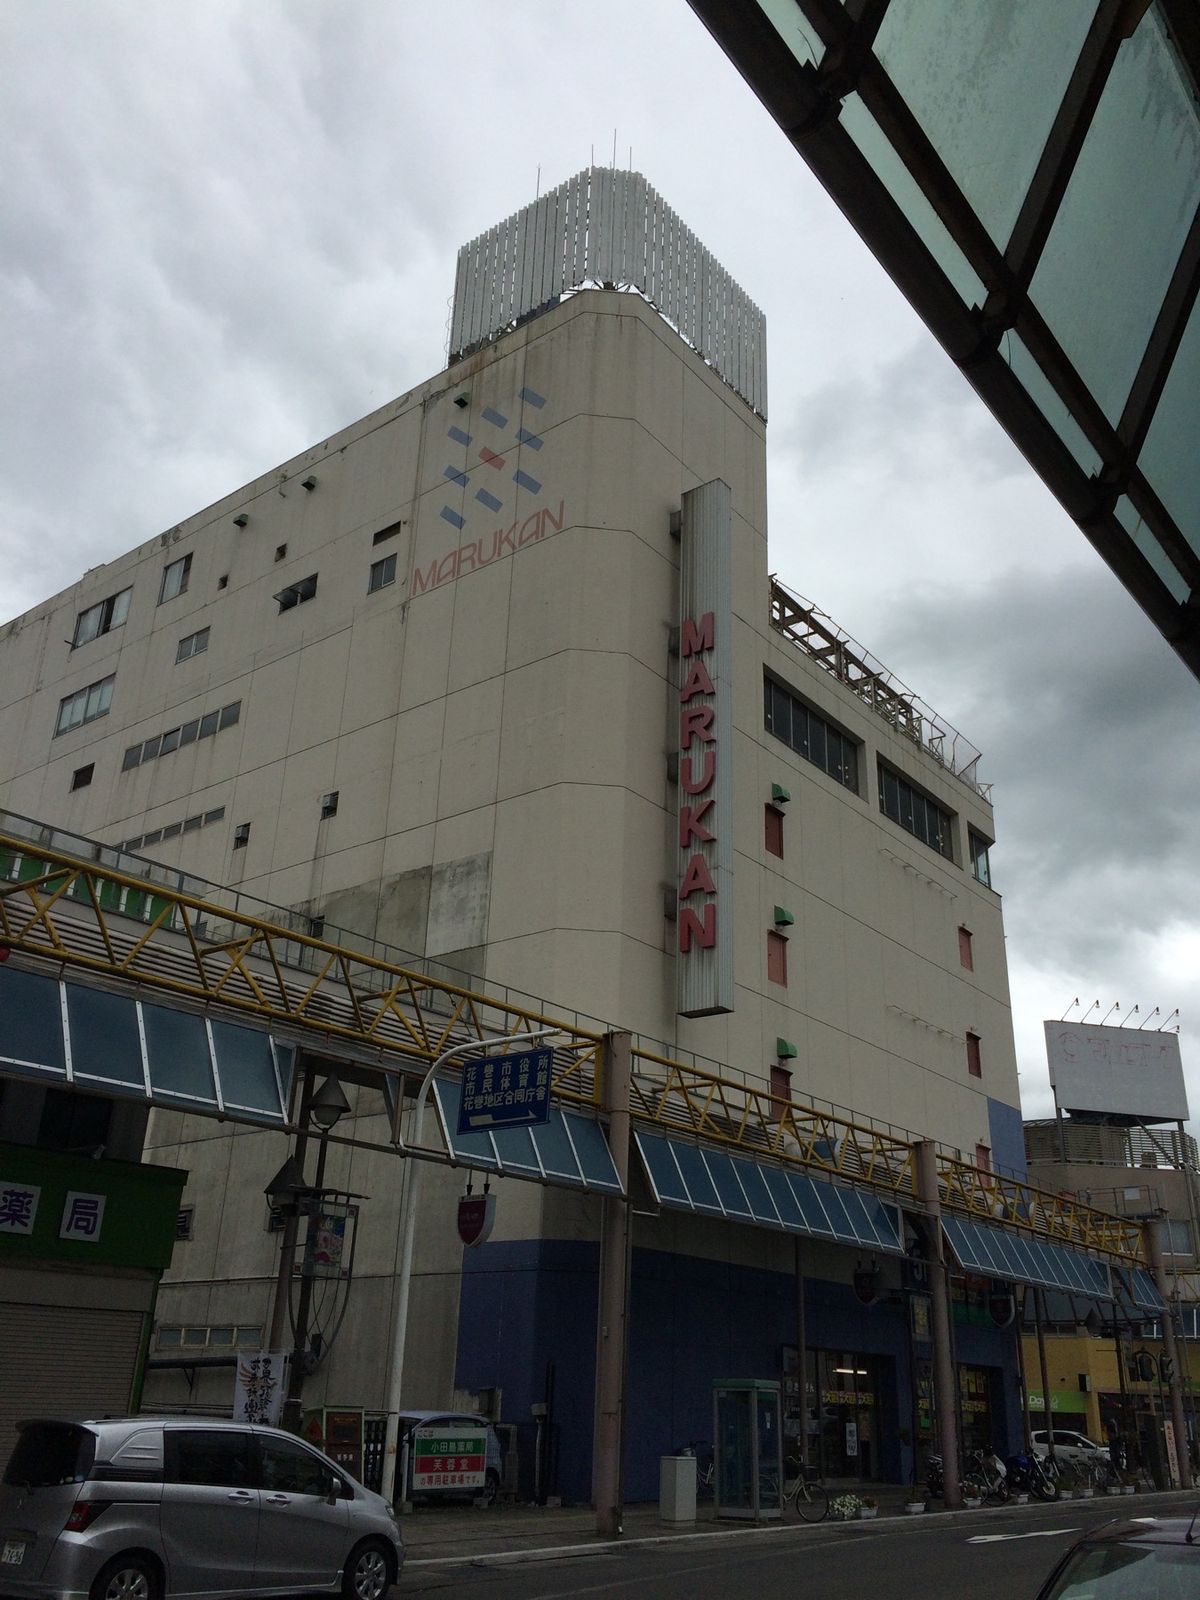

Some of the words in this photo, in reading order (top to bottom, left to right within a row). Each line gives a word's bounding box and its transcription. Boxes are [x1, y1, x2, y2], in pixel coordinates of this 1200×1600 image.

[679, 611, 717, 953] MARUKAN
[466, 1055, 549, 1081] 花巻市役所
[465, 1071, 548, 1096] 市民体育館
[463, 1087, 546, 1110] 花巻地区合同庁舎
[0, 1189, 99, 1235] 薬局
[431, 1441, 474, 1453] 小田島薬局
